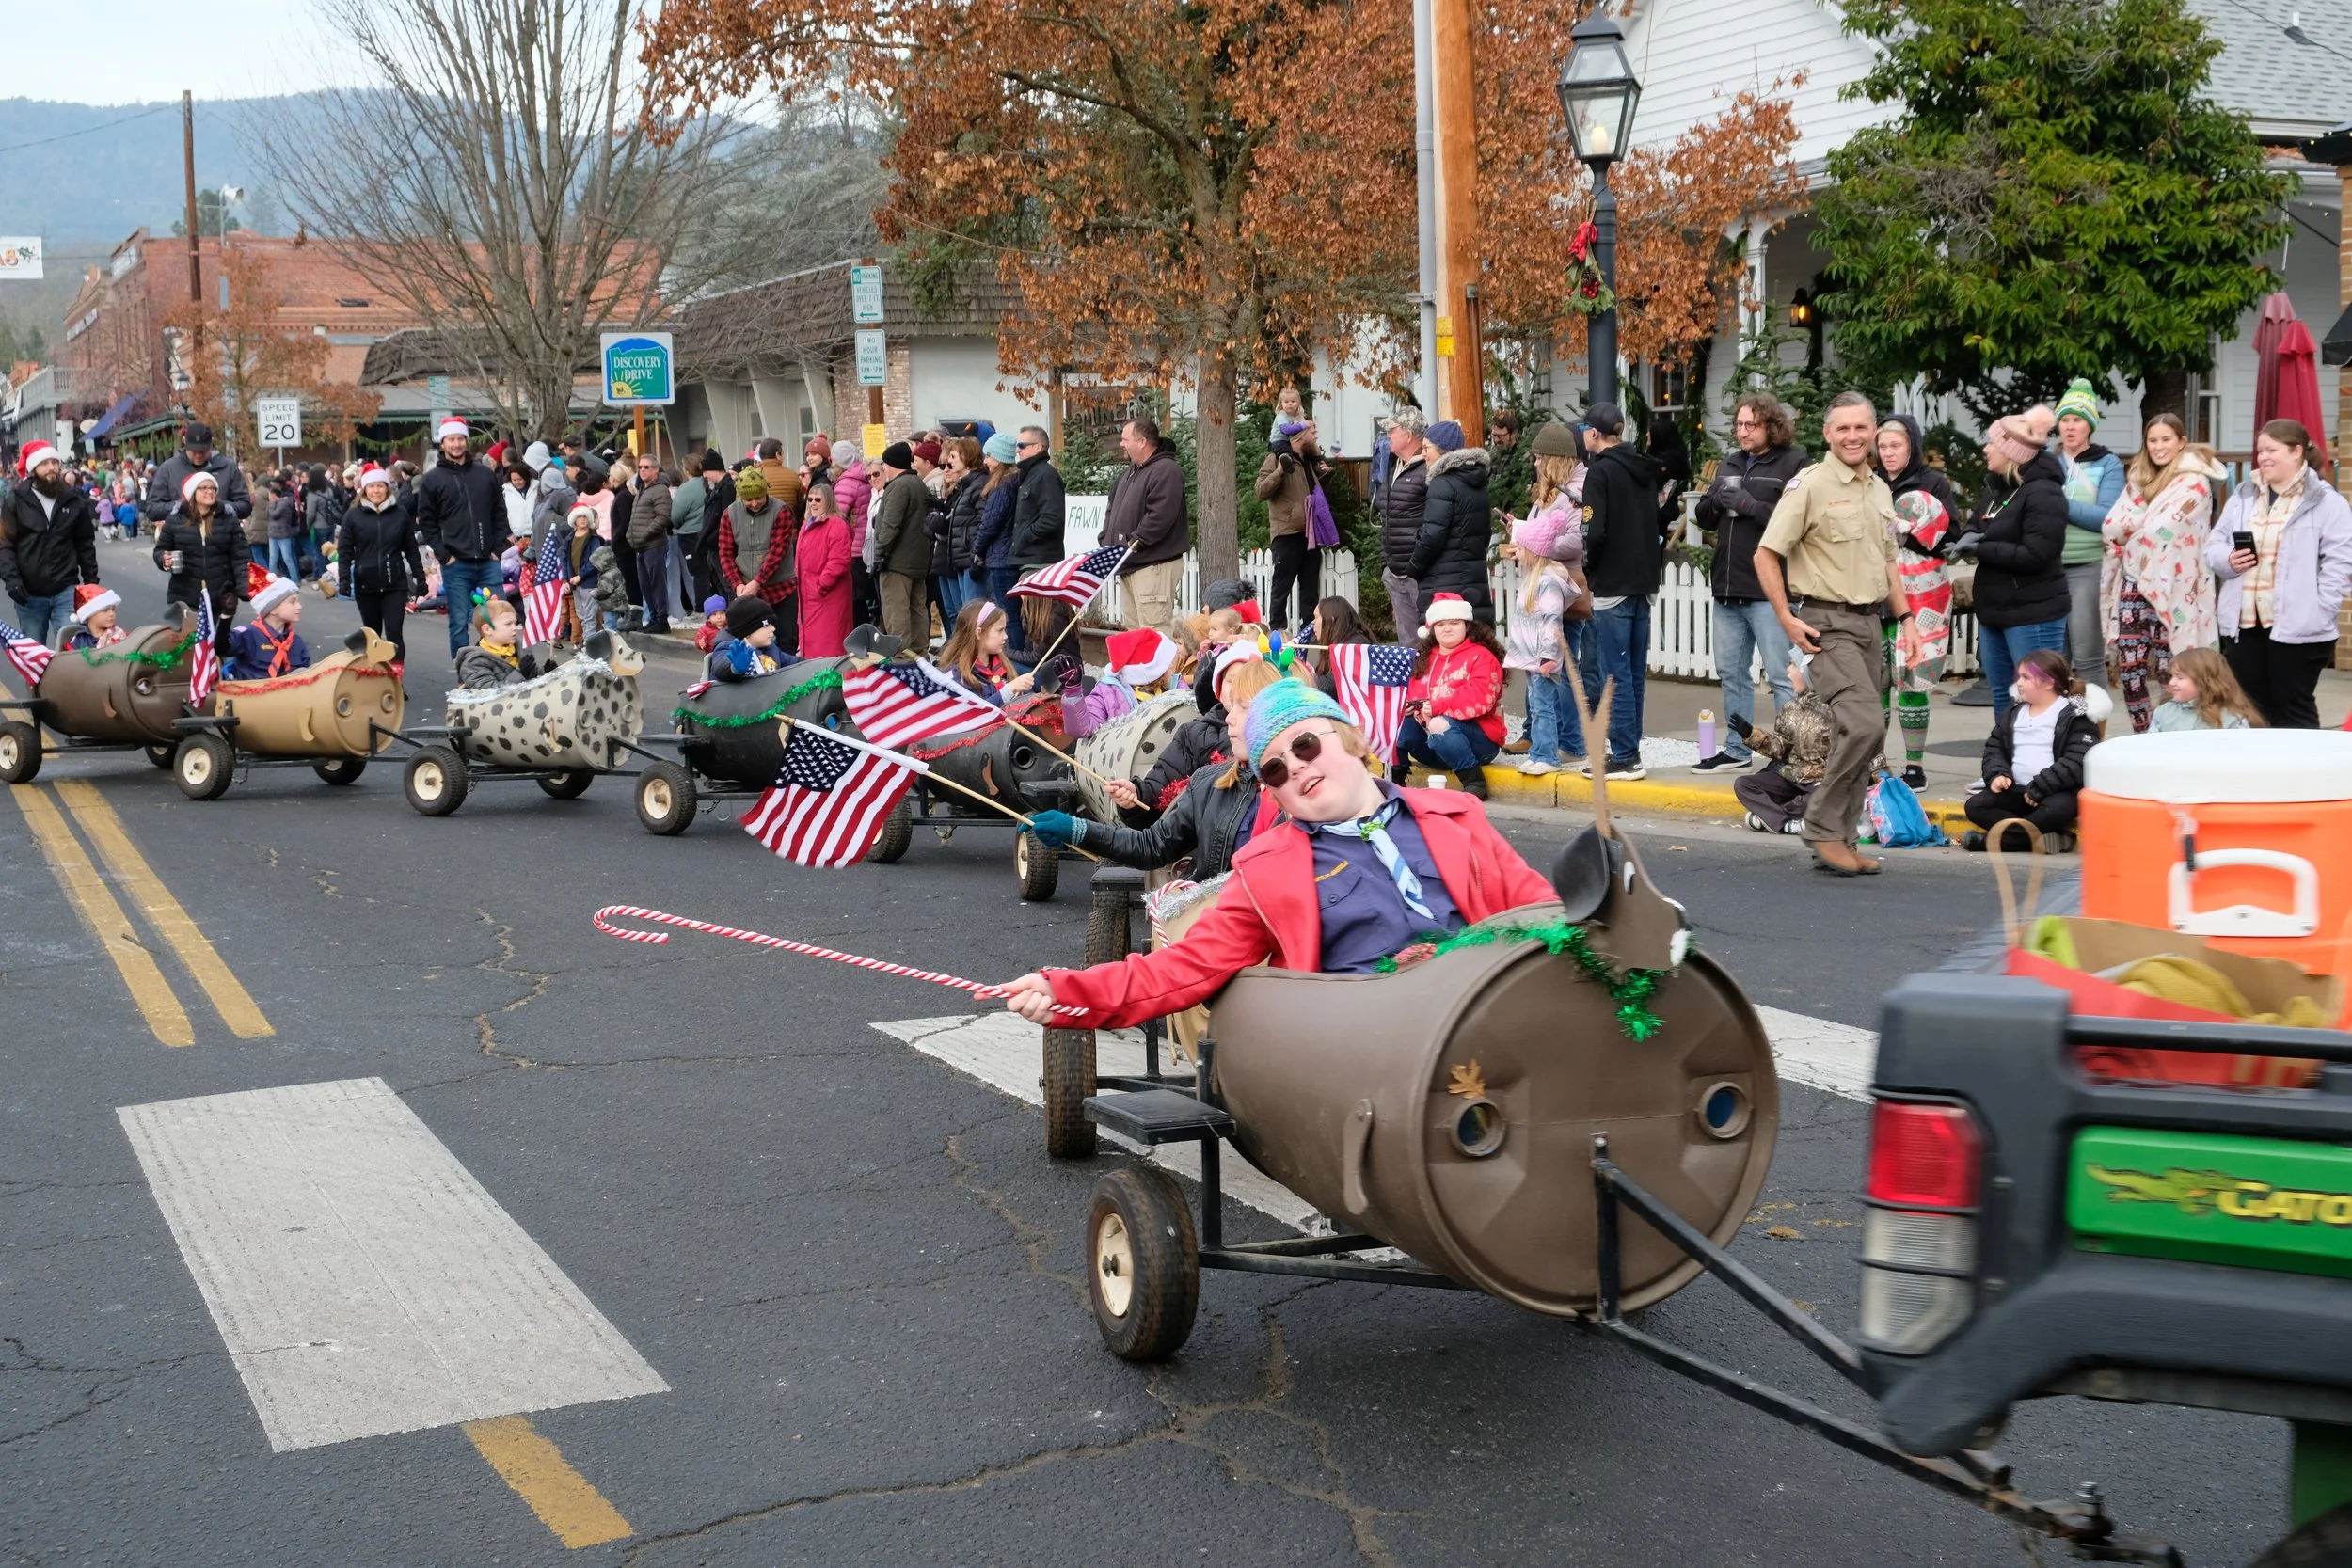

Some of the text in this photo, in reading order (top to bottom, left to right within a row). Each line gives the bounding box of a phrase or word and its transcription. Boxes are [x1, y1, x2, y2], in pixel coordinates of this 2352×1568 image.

[613, 356, 660, 368] DISCOVERY
[625, 369, 653, 380] DRIVE
[262, 404, 295, 412] SPEED
[265, 413, 292, 421] LIMIT
[264, 424, 294, 440] 20
[1067, 506, 1102, 528] FAWN
